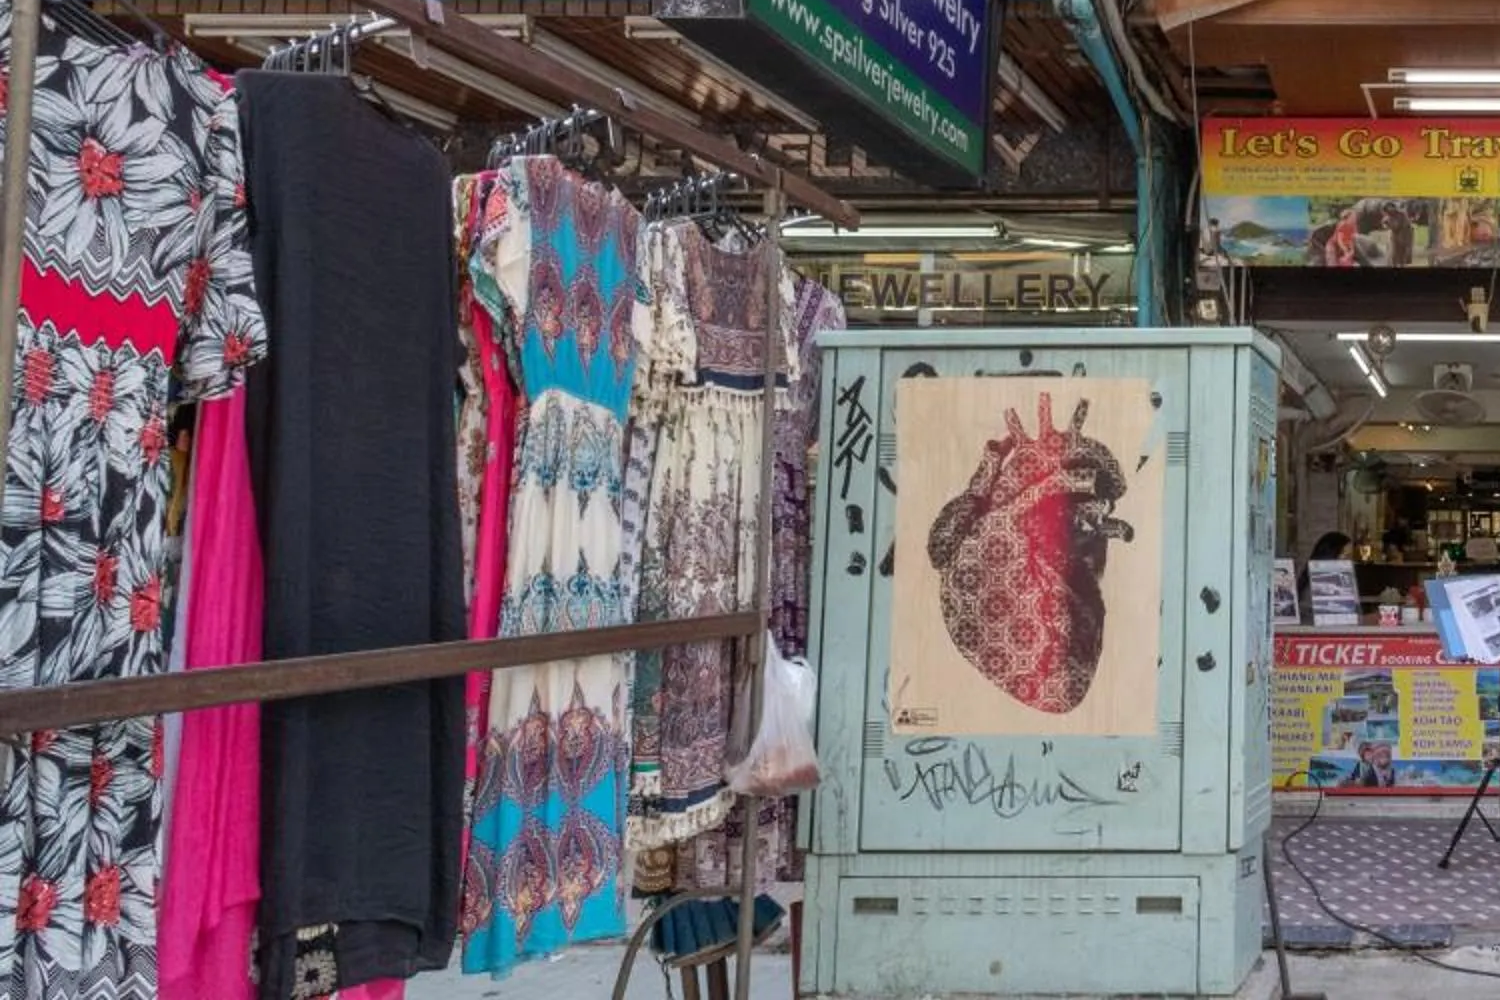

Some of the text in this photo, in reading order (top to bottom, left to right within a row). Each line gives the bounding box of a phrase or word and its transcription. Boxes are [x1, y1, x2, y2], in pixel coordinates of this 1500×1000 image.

[927, 30, 956, 79] 925
[1219, 126, 1319, 159] Let's
[1338, 128, 1401, 159] Go
[1296, 643, 1384, 665] TICKET
